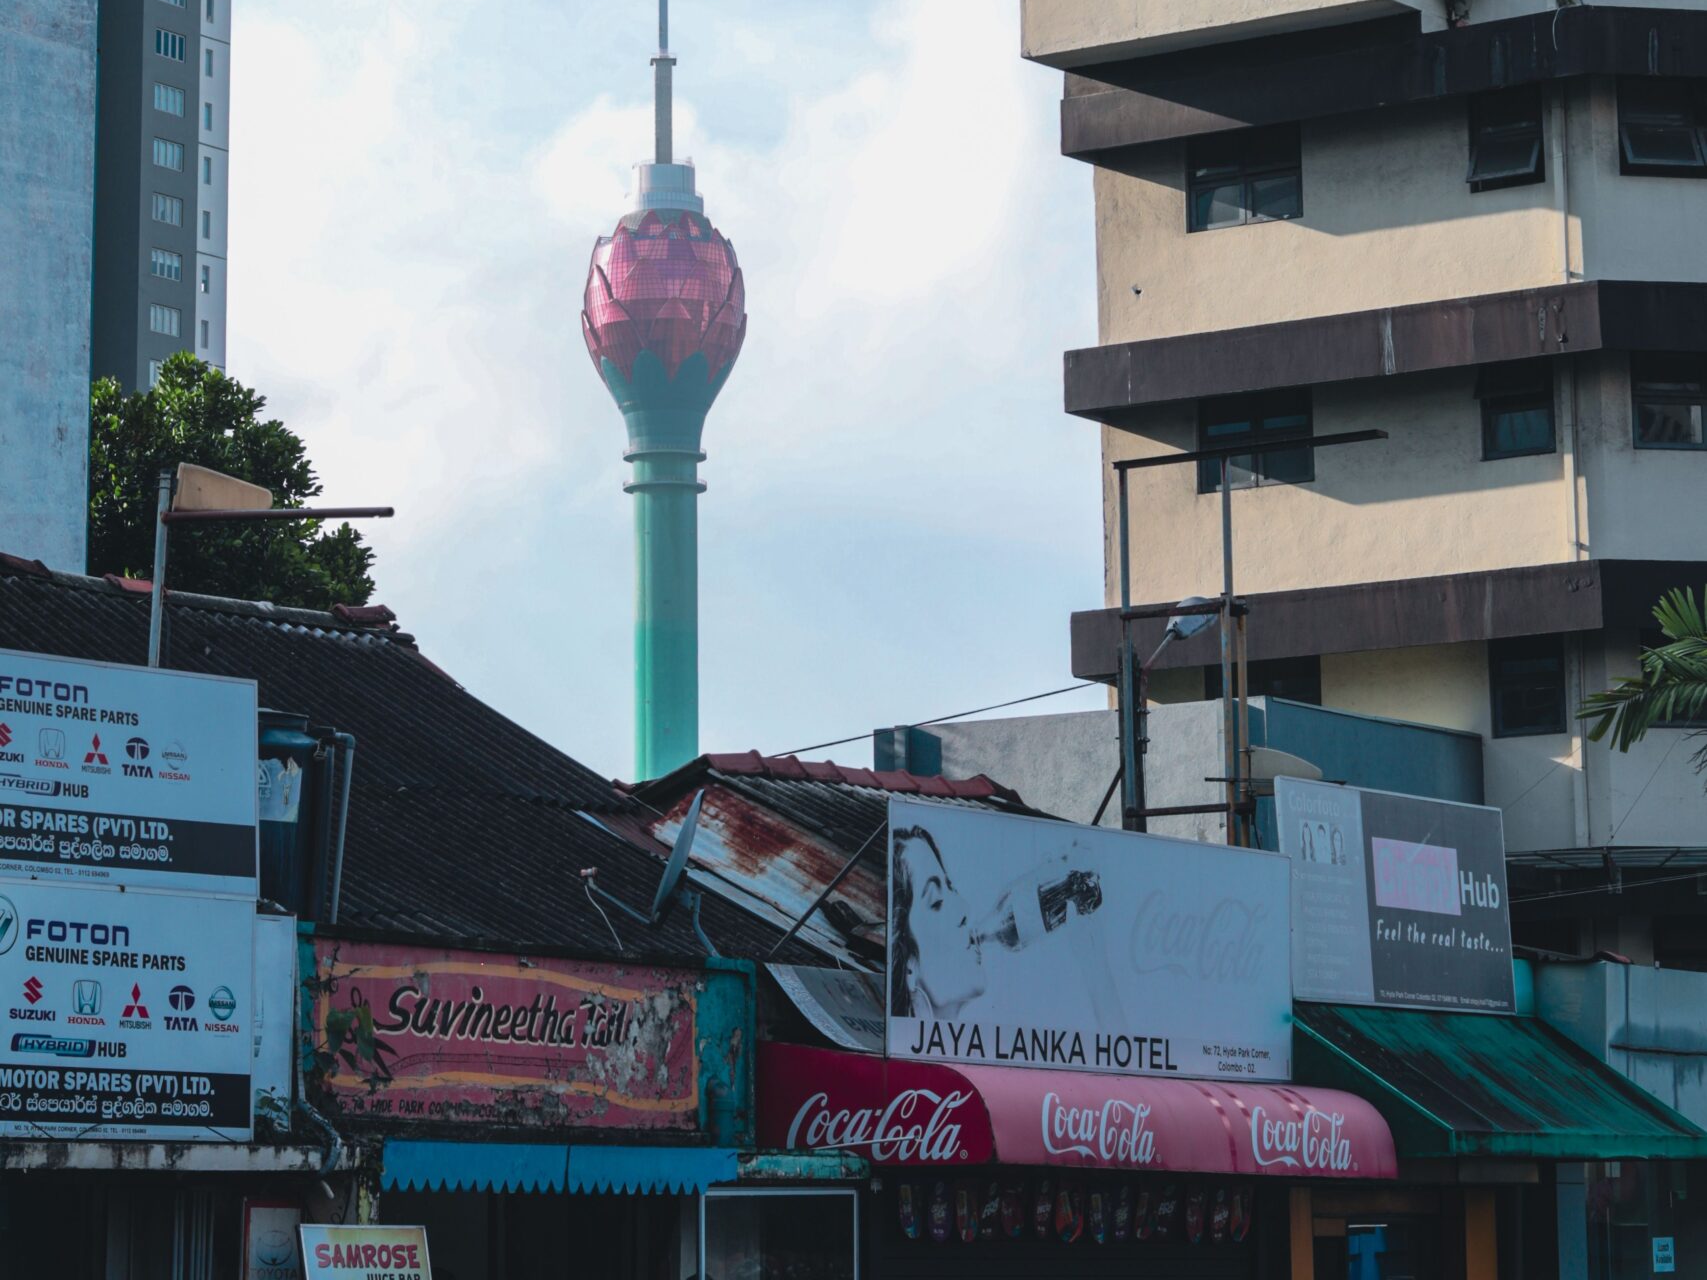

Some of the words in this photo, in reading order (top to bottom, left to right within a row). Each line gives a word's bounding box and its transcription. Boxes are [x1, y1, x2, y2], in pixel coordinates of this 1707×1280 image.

[0, 697, 52, 717] GENUINE
[56, 705, 97, 722] SPARE
[100, 710, 139, 726] PARTS
[35, 760, 69, 769] HONDA
[81, 765, 111, 775] MITSUBISHI
[122, 764, 153, 779] TATA
[159, 771, 191, 781] NISSAN
[63, 782, 89, 798] HUB
[20, 810, 89, 834] SPARES
[93, 816, 137, 841] (PVT)
[140, 821, 174, 841] LTD.
[1460, 870, 1500, 909] Hub
[26, 918, 129, 946] FOTON
[1131, 889, 1268, 983] Coca-Cola
[1377, 919, 1402, 941] Feel
[1407, 922, 1426, 944] the
[1432, 927, 1455, 947] real
[1461, 930, 1504, 953] taste...
[25, 946, 89, 965] GENUINE
[93, 950, 138, 969] SPARE
[142, 953, 186, 971] PARTS
[9, 1008, 56, 1022] SUZUKI
[67, 1016, 106, 1026] HONDA
[119, 1020, 152, 1030] MITSUBISHI
[164, 1016, 198, 1032] TATA
[373, 985, 576, 1047] Suvineetha
[204, 1023, 239, 1033] NISSAN
[23, 1039, 84, 1052] HYBRID
[98, 1042, 127, 1058] HUB
[911, 1020, 985, 1058] JAYA
[995, 1025, 1086, 1065] LANKA
[1095, 1033, 1178, 1071] HOTEL
[1222, 1046, 1237, 1059] Hyde
[1238, 1048, 1250, 1058] Park
[1218, 1061, 1243, 1072] Colombo
[0, 1068, 60, 1090] MOTOR
[64, 1071, 132, 1092] SPARES
[135, 1074, 179, 1098] (PVT)
[182, 1076, 215, 1096] LTD.
[399, 1100, 424, 1114] PARK
[786, 1089, 973, 1161] Coca-Cola
[1042, 1092, 1156, 1163] Coca-Cola
[1251, 1106, 1352, 1171] Coca-Cola
[315, 1243, 421, 1269] SAMROSE
